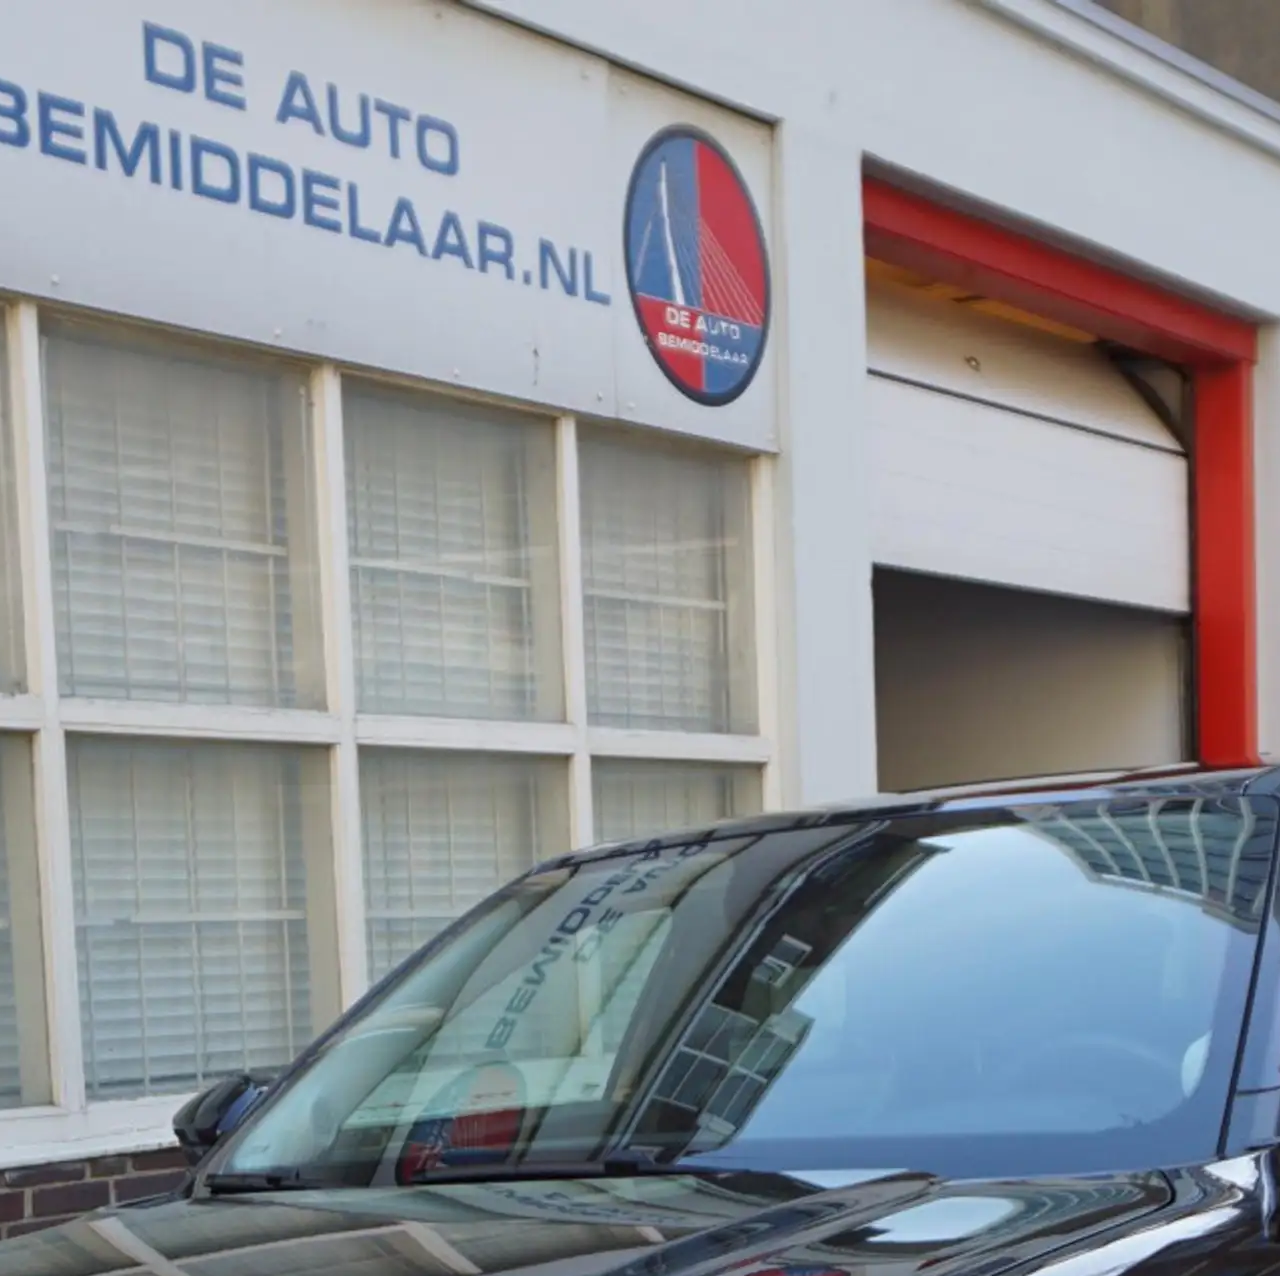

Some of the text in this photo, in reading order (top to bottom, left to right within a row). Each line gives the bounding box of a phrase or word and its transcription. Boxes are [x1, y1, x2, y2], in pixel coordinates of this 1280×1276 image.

[141, 21, 461, 179] DE AUTO
[665, 306, 741, 340] DE AUTO
[657, 331, 749, 365] BEMIDDELAAR
